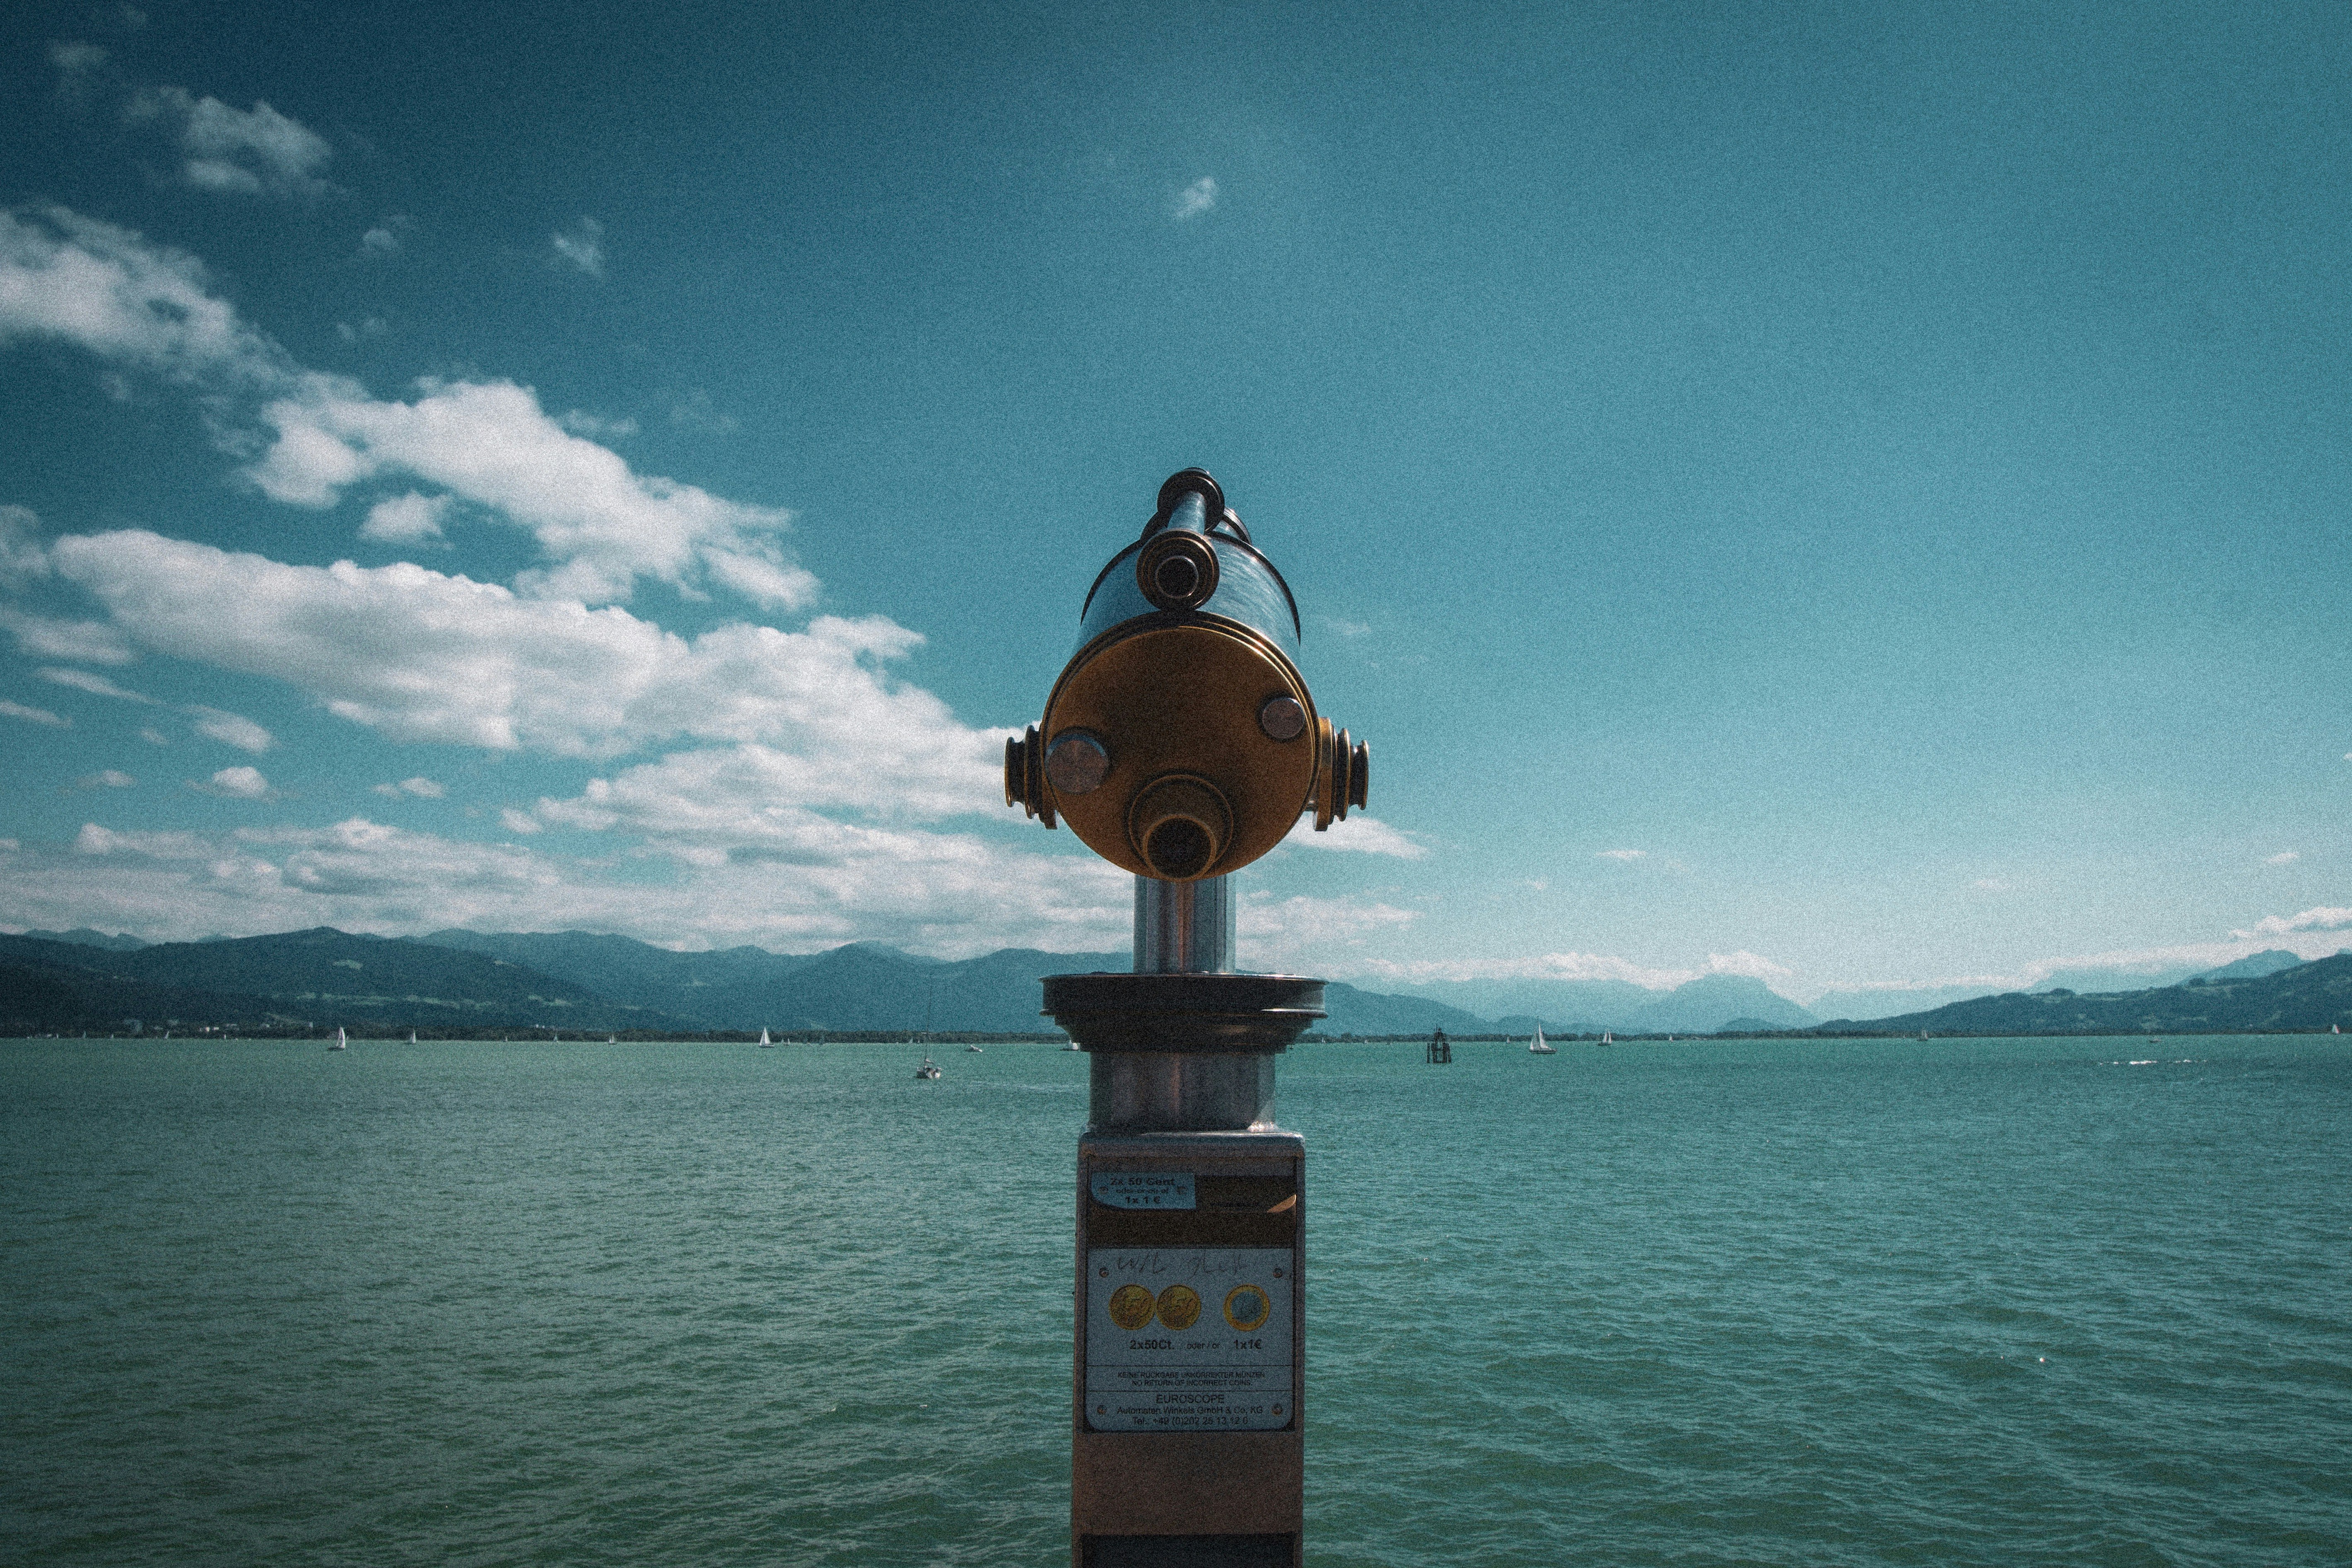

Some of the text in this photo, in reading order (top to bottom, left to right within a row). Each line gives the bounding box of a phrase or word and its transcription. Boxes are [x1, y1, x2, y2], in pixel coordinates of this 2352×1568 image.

[1130, 1339, 1175, 1350] 2x50Ct.
[1233, 1339, 1262, 1350] 1x1€
[1156, 1394, 1225, 1404] EUROSCOPE
